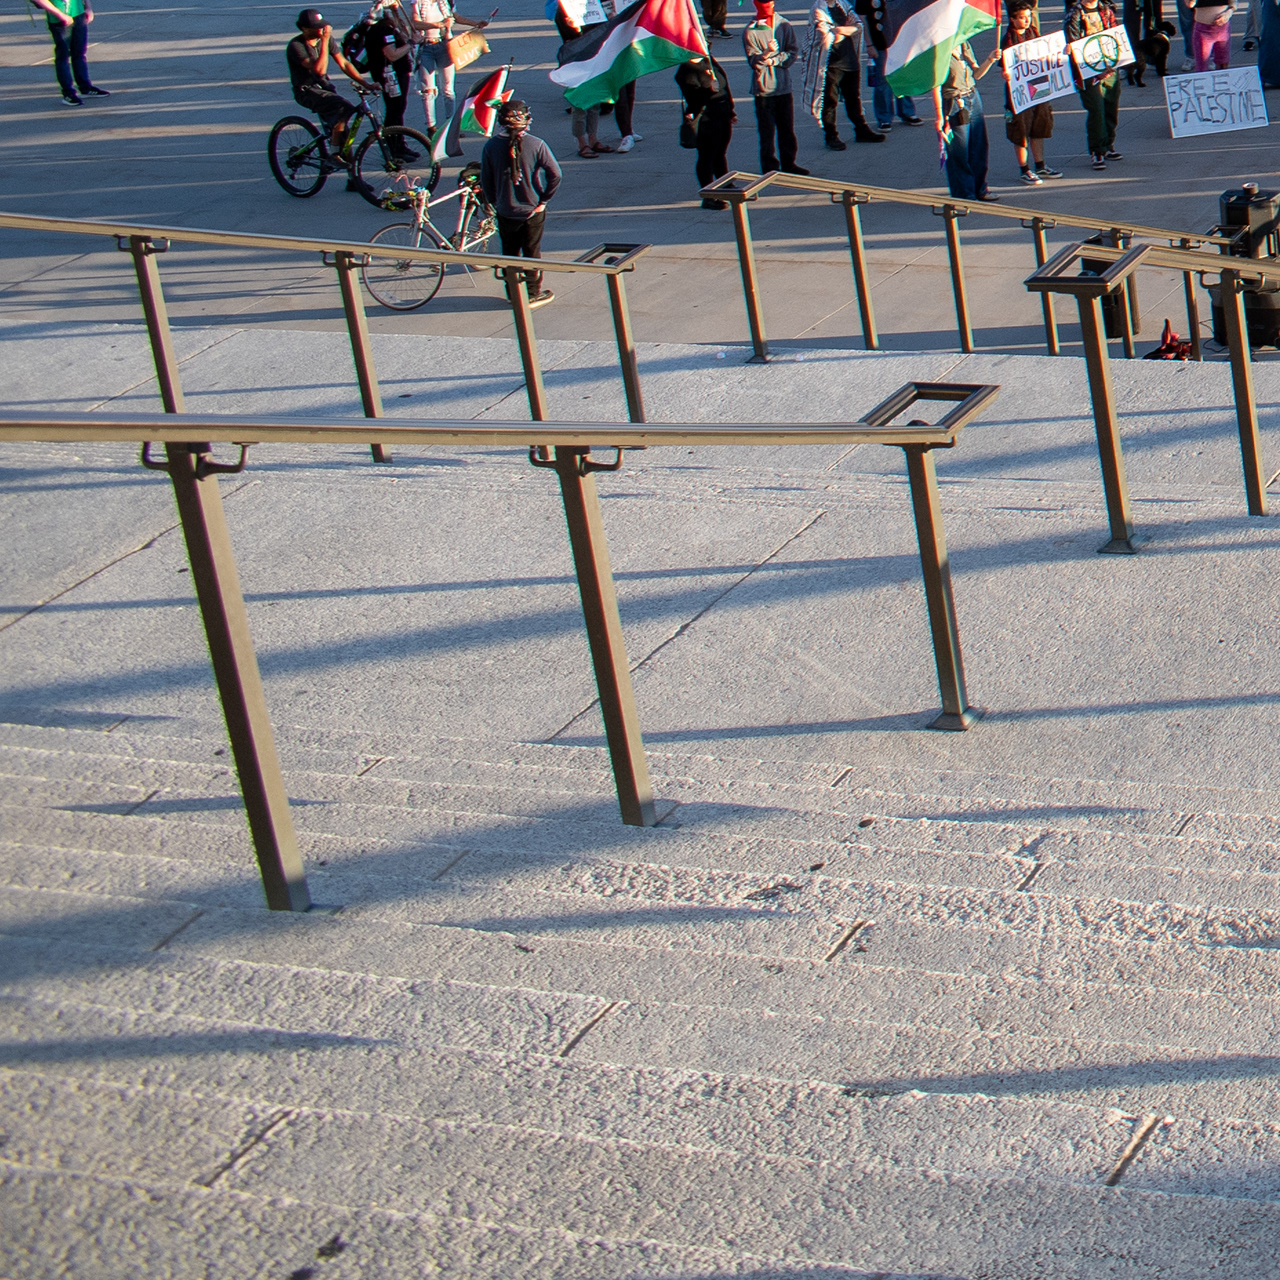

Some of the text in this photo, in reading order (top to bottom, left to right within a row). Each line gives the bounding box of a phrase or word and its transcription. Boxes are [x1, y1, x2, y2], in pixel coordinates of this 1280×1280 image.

[1013, 51, 1064, 82] JUSTICE
[1012, 69, 1072, 110] FOR ALL
[1166, 73, 1231, 101] FREE
[1170, 89, 1267, 129] PALESTINE
